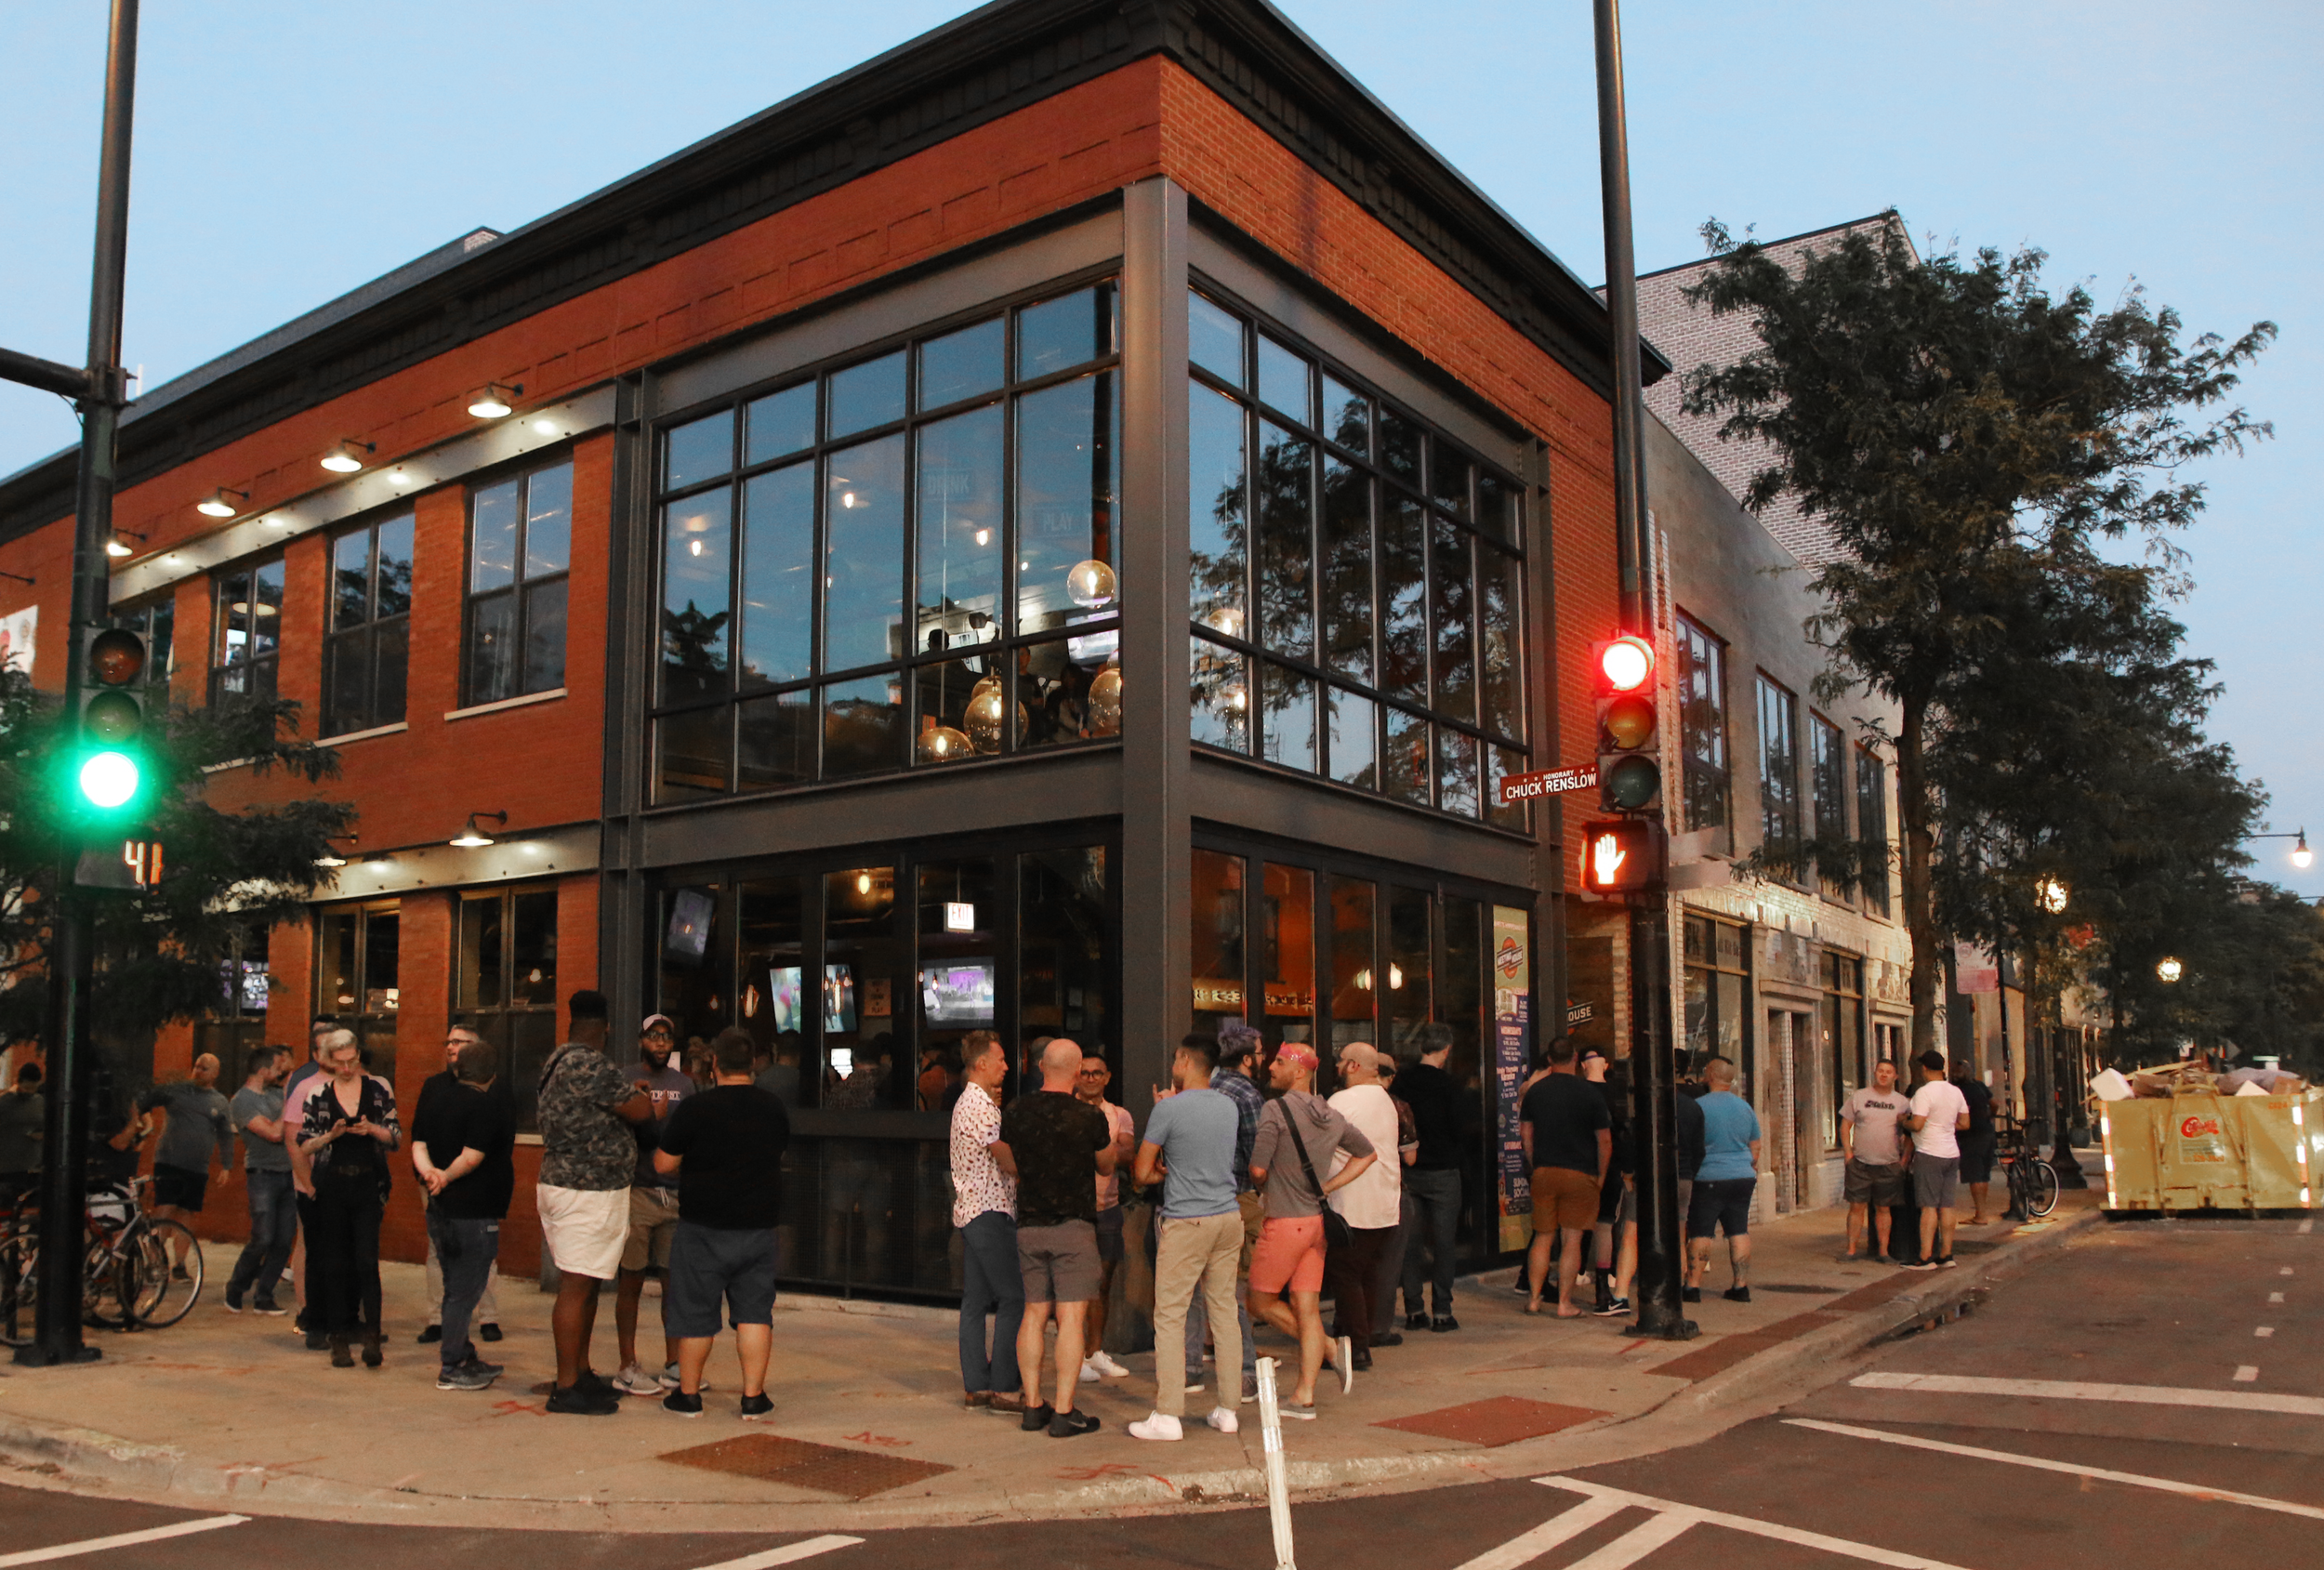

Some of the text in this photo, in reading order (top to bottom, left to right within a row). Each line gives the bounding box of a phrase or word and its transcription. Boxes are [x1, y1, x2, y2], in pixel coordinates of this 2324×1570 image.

[1543, 769, 1575, 780] HONORARY
[1506, 773, 1596, 799] CHUCK RENSLOW
[952, 904, 969, 921] EXIT
[1568, 1006, 1591, 1022] OUSE
